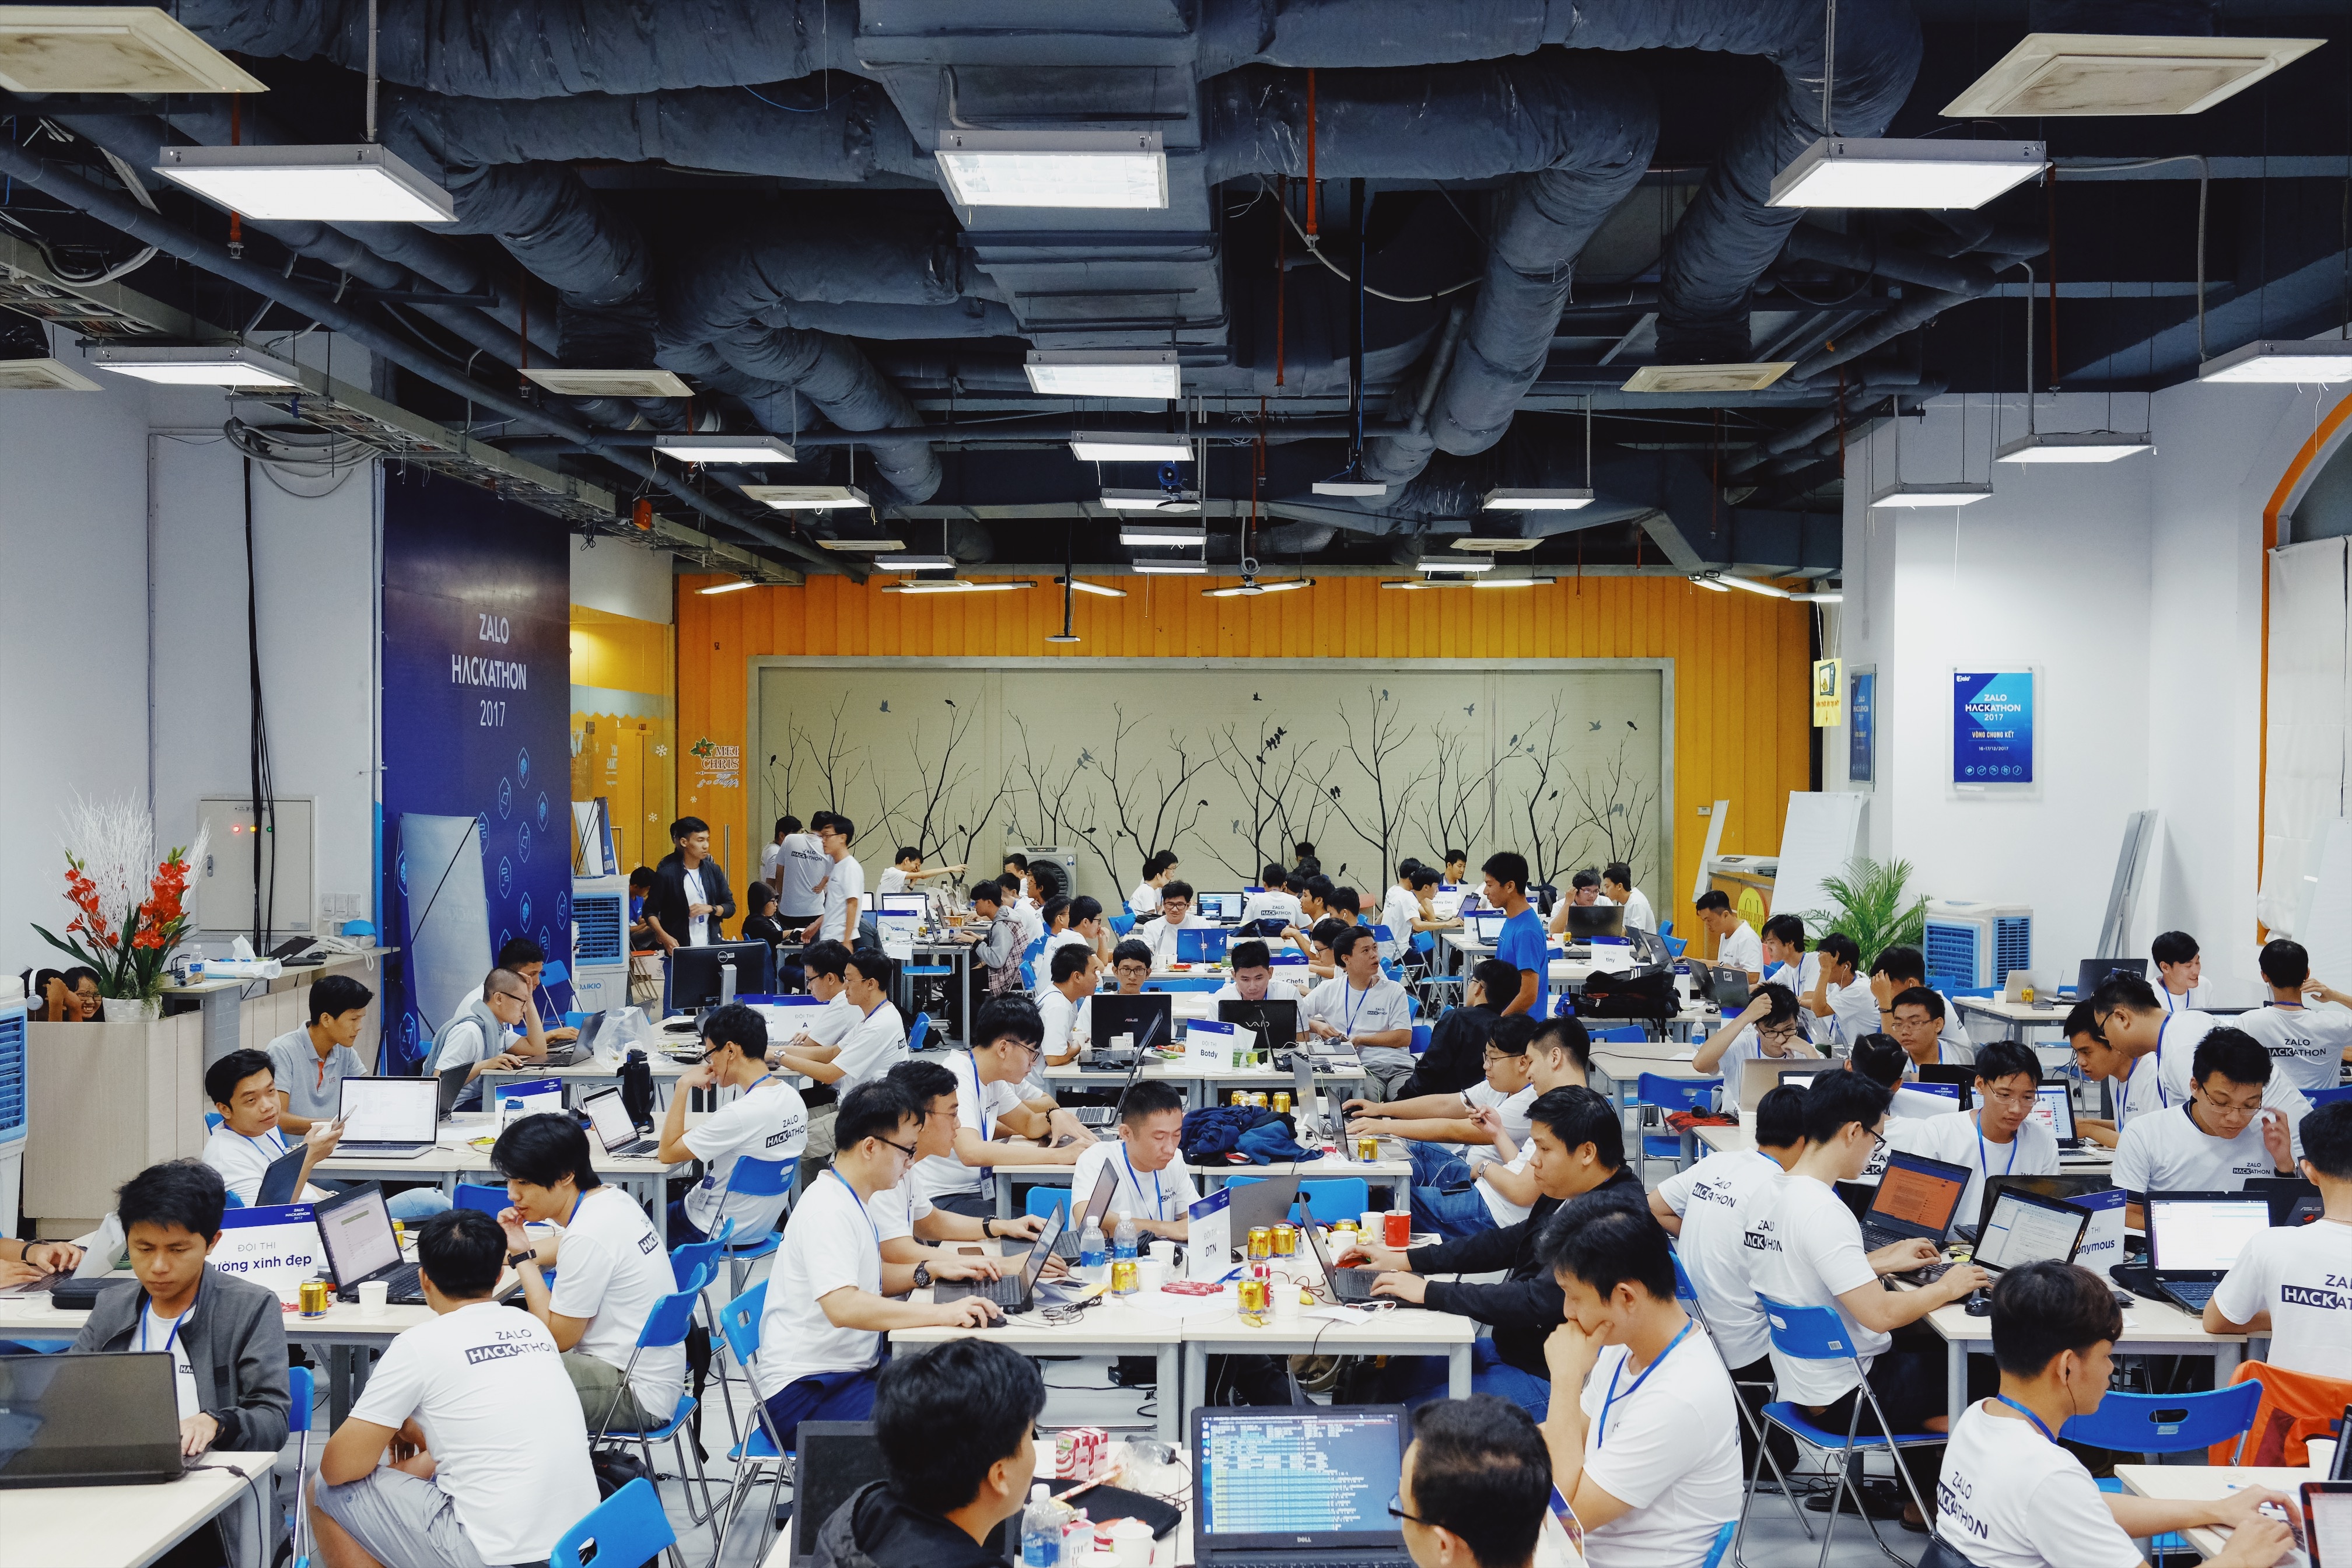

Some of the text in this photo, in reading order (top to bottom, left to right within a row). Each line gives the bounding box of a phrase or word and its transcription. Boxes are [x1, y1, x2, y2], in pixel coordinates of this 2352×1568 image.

[480, 614, 509, 644] ZALO
[452, 654, 526, 690] HACKATHON
[480, 699, 505, 726] 2017
[792, 851, 822, 862] HACKATHON
[1200, 1049, 1218, 1059] Botdy
[783, 1115, 799, 1128] ZALO
[260, 1241, 276, 1250] THI
[1206, 1242, 1217, 1258] DTN
[253, 1256, 281, 1269] xinh
[286, 1254, 312, 1267] đẹp
[495, 1329, 532, 1340] ZALO
[466, 1342, 557, 1364] HACKATHON
[1952, 1471, 1972, 1500] ZALO
